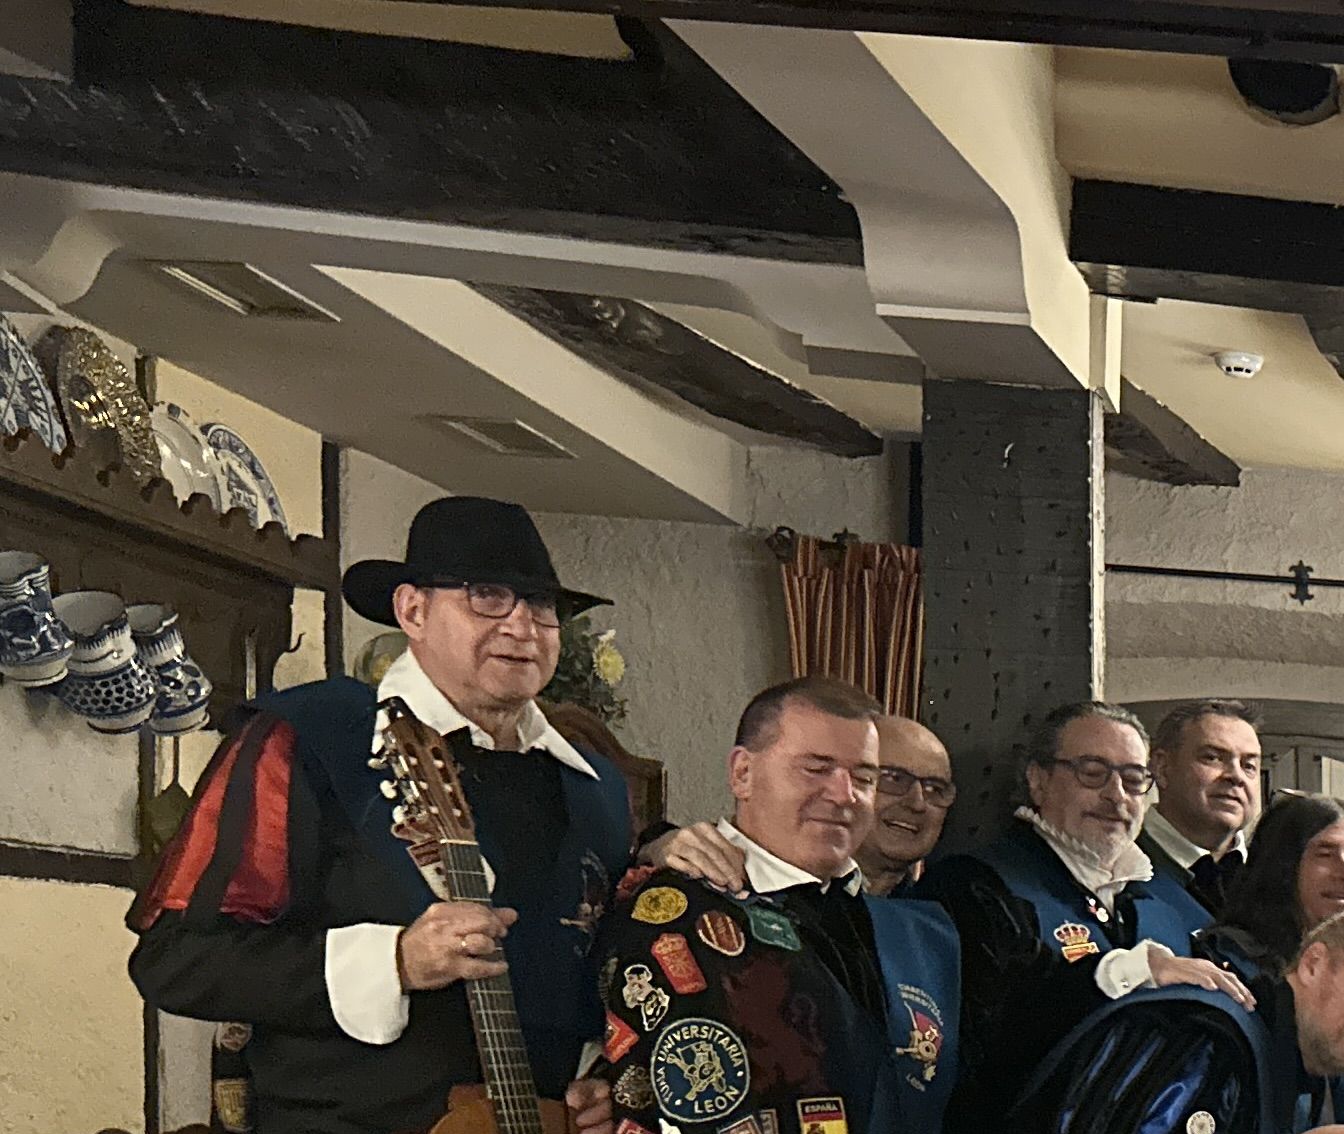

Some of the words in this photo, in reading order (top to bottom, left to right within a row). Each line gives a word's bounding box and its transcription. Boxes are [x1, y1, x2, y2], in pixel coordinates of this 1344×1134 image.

[657, 1025, 743, 1067] UNIVERSITARIA
[656, 1066, 674, 1103] TUNA
[694, 1085, 740, 1114] LEON
[805, 1102, 838, 1114] ESPAÑA
